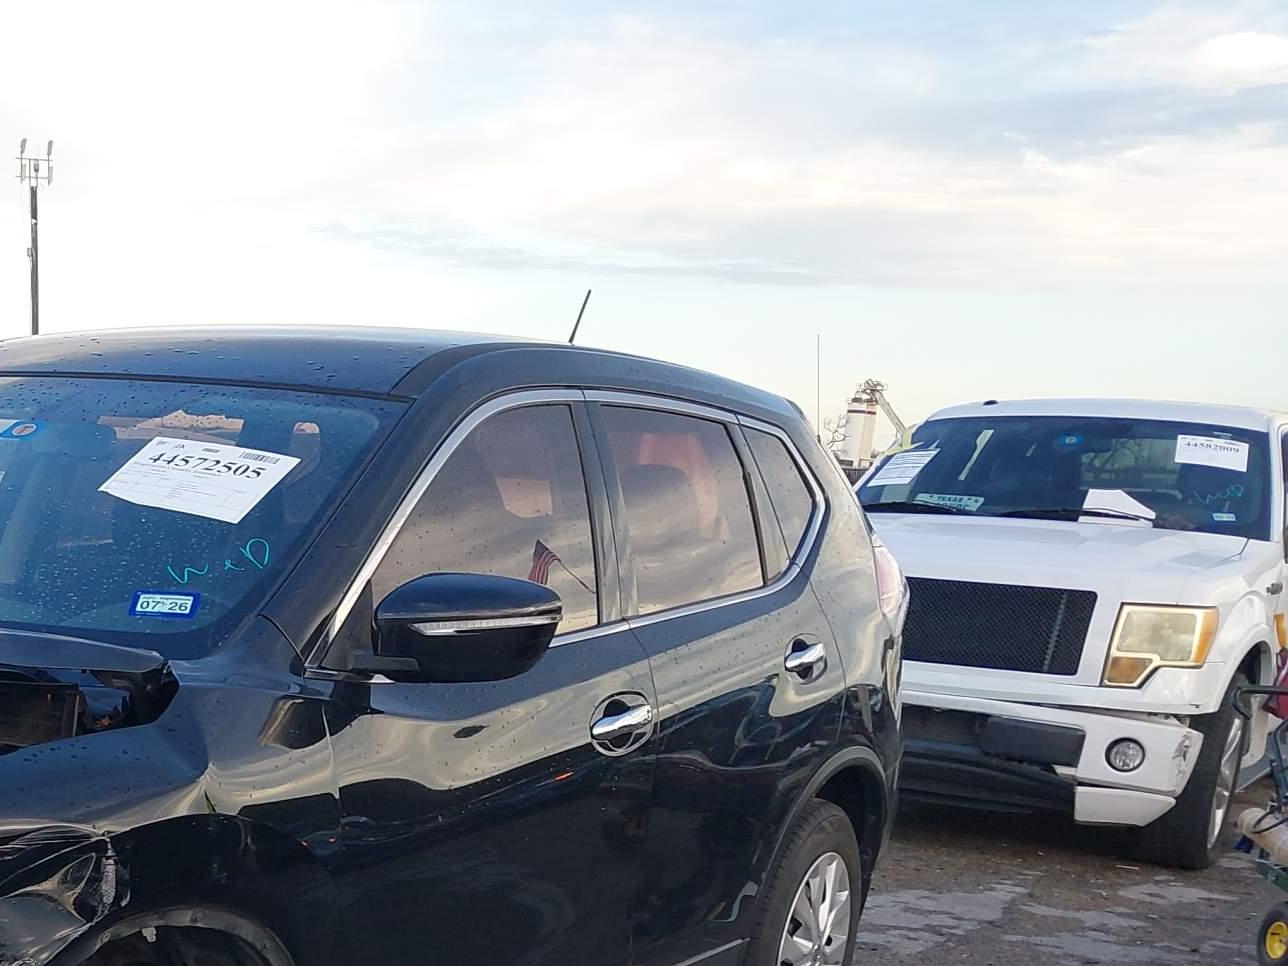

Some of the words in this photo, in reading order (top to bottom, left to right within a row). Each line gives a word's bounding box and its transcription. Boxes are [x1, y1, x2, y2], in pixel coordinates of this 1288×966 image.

[149, 452, 267, 479] 44572505
[139, 600, 161, 610] 07
[167, 601, 189, 611] 26
